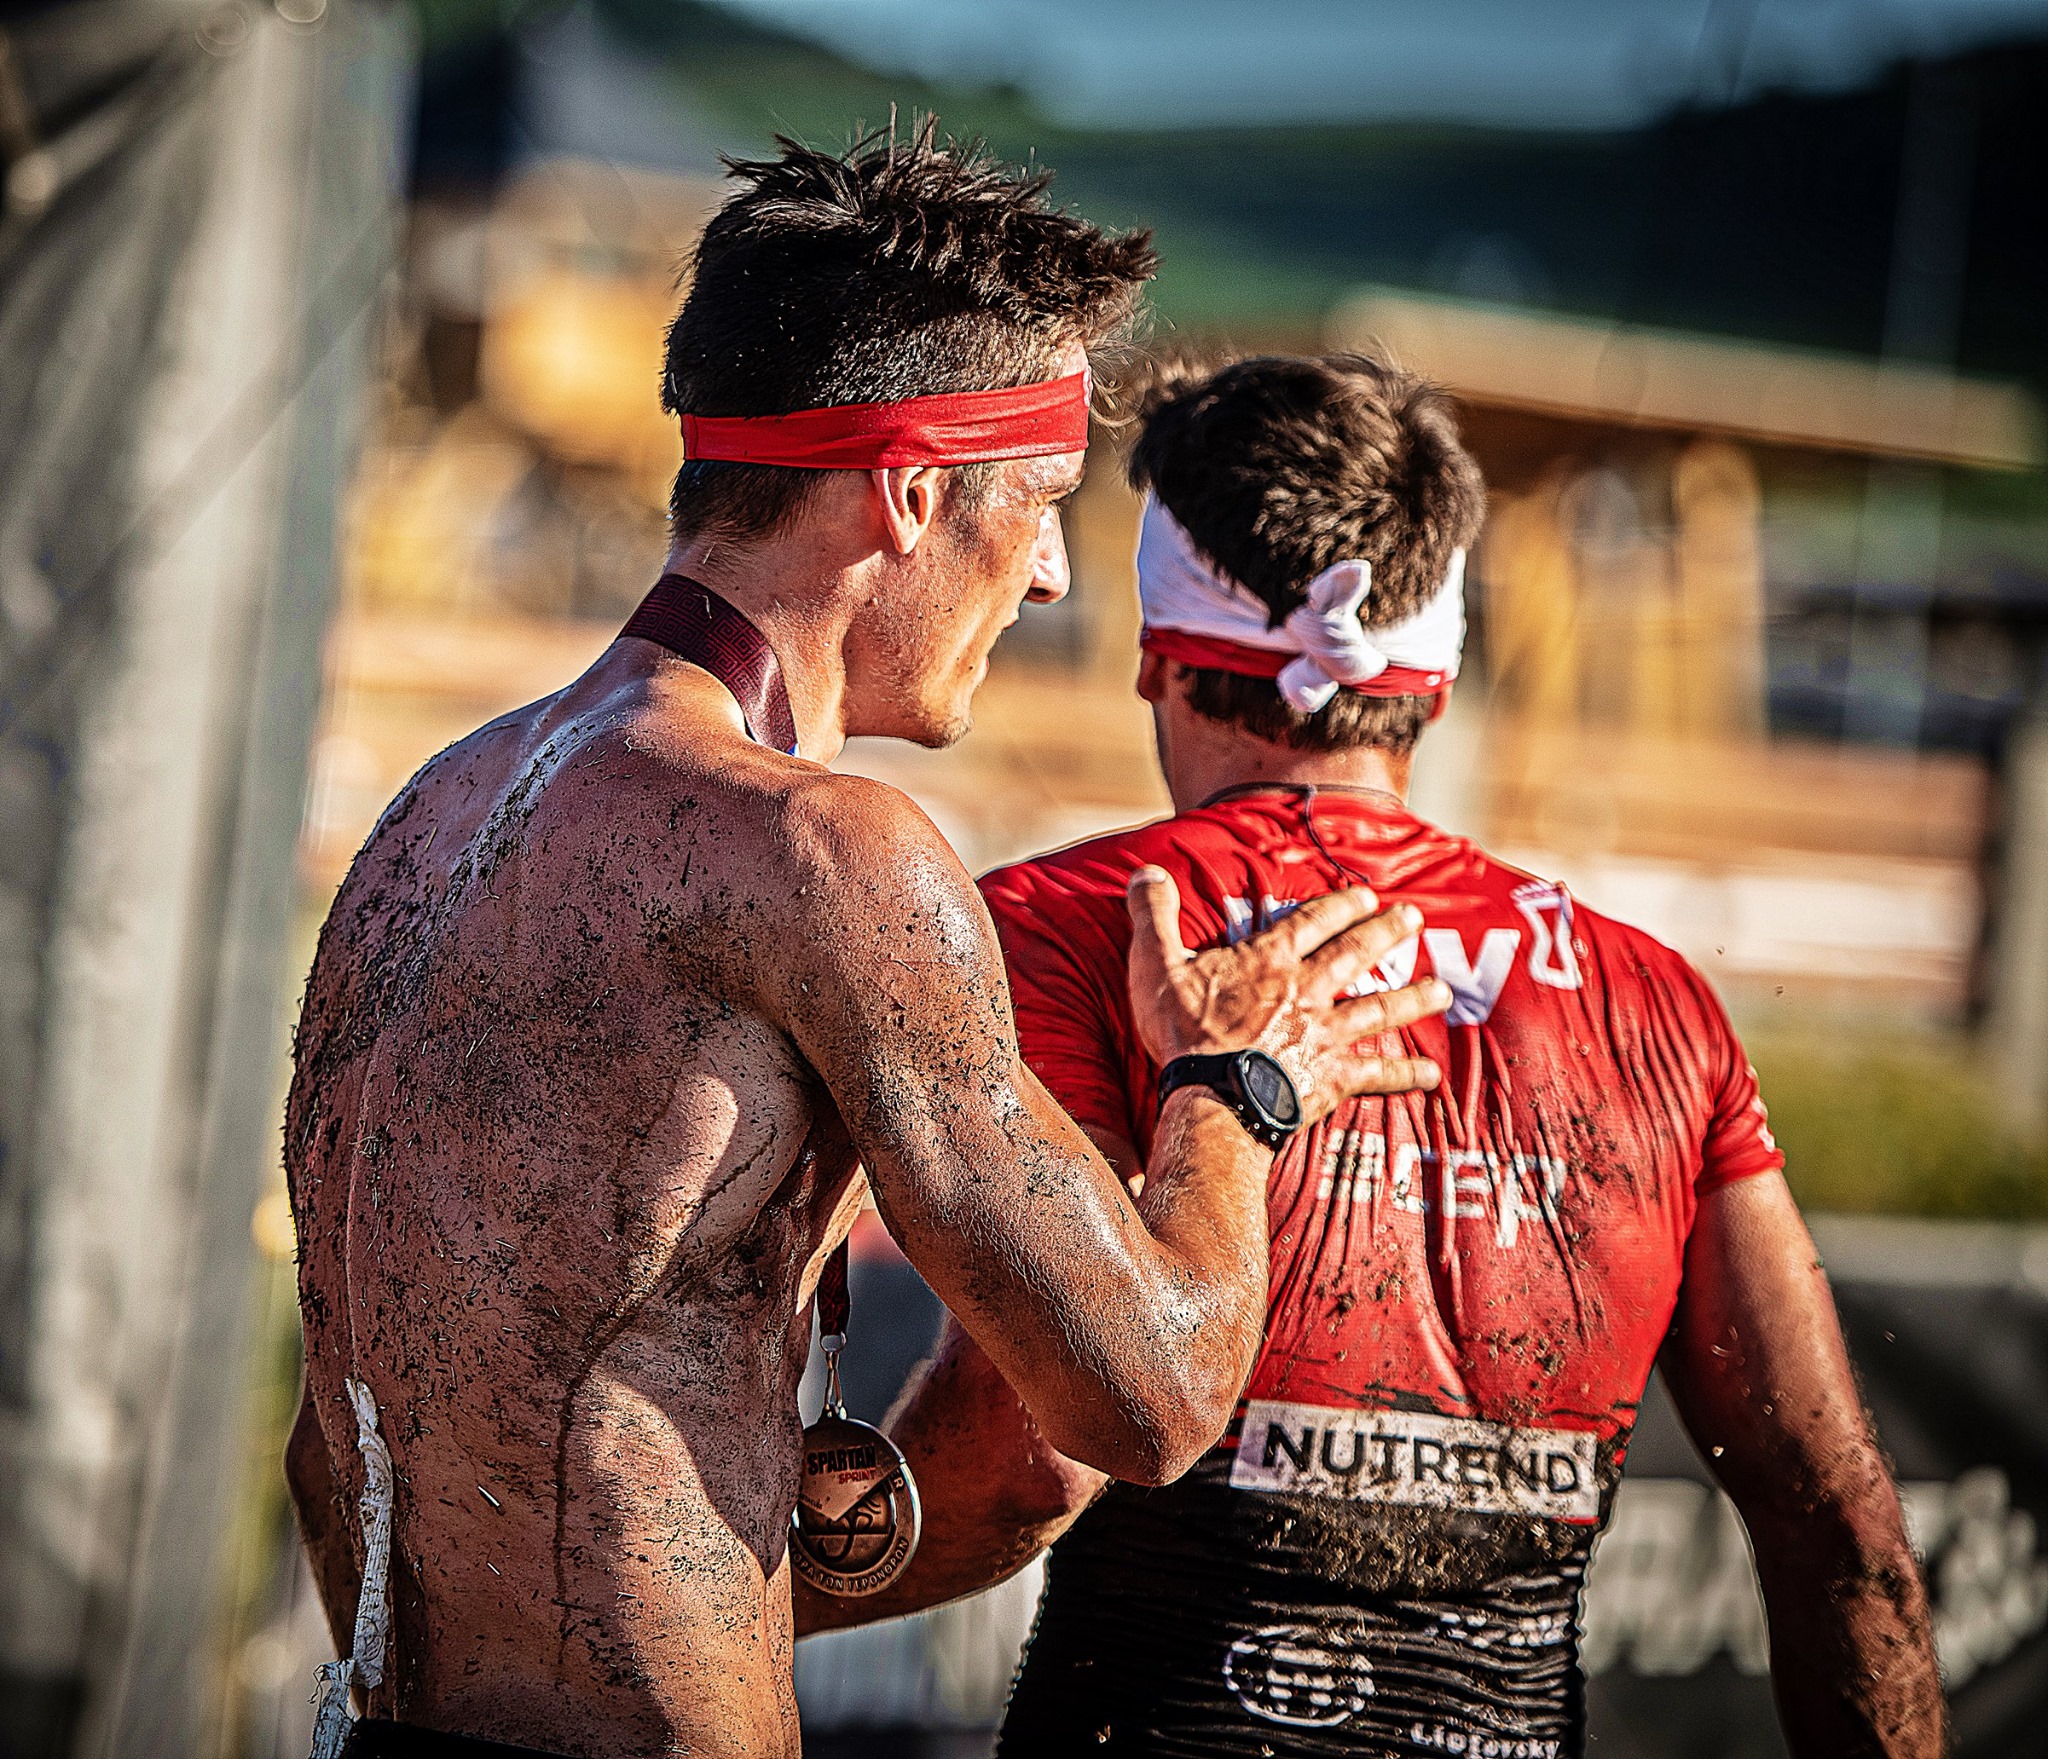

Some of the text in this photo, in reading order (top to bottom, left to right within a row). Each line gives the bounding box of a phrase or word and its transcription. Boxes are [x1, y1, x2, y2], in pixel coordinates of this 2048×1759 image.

[807, 1445, 876, 1475] SPARTAN
[1263, 1423, 1578, 1493] NUTREND
[839, 1468, 876, 1484] SPRINT
